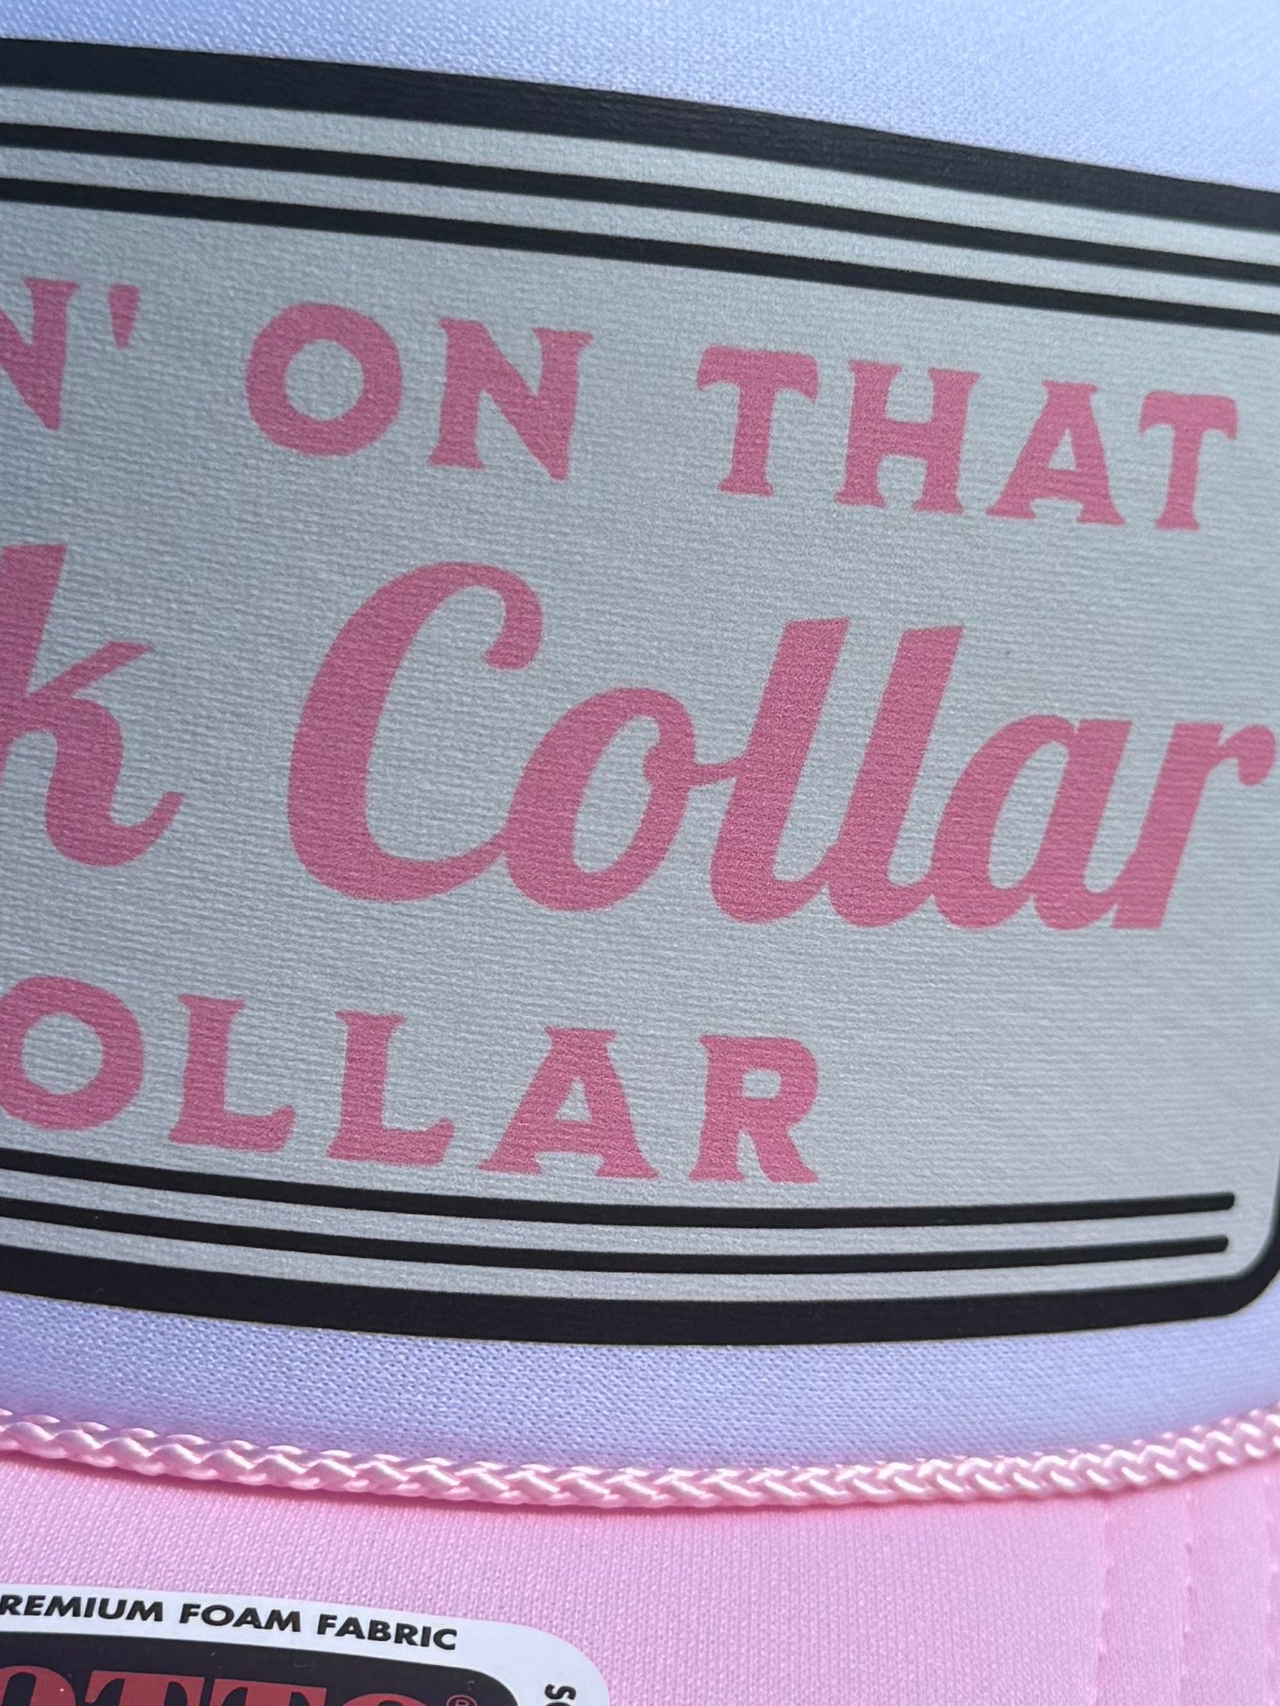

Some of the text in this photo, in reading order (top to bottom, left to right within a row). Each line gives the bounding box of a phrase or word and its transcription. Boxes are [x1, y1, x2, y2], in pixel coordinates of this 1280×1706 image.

[243, 302, 594, 481] ON
[697, 347, 1236, 533] THAT
[284, 562, 1276, 931] Collar
[179, 1602, 302, 1634] FOAM
[317, 1614, 458, 1651] FABRIC
